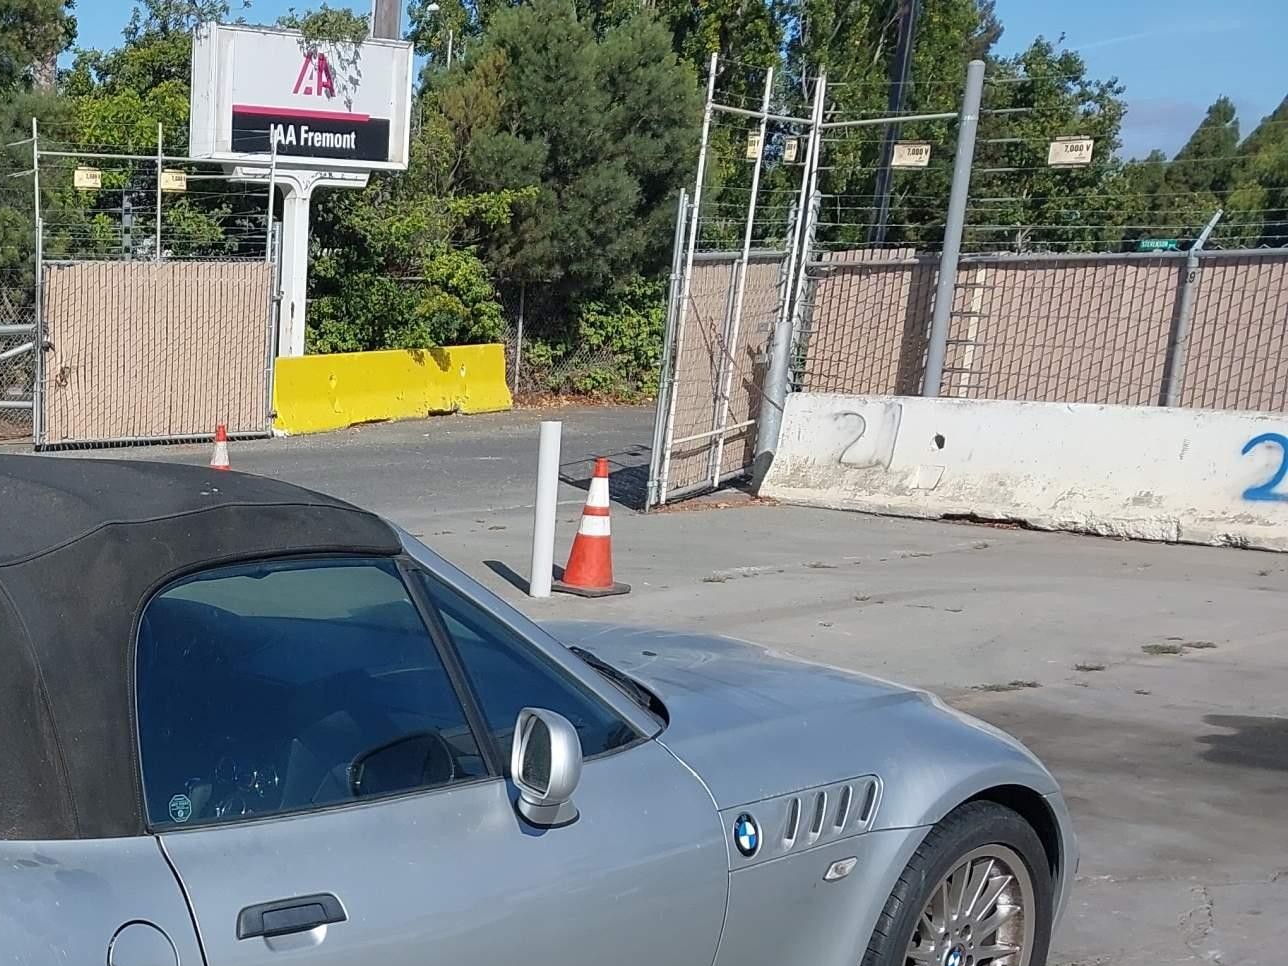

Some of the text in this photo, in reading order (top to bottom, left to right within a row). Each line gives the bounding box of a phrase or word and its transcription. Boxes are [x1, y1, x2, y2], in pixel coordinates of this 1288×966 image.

[270, 123, 356, 149] IAA Fremont
[1064, 143, 1092, 153] 7,000 V
